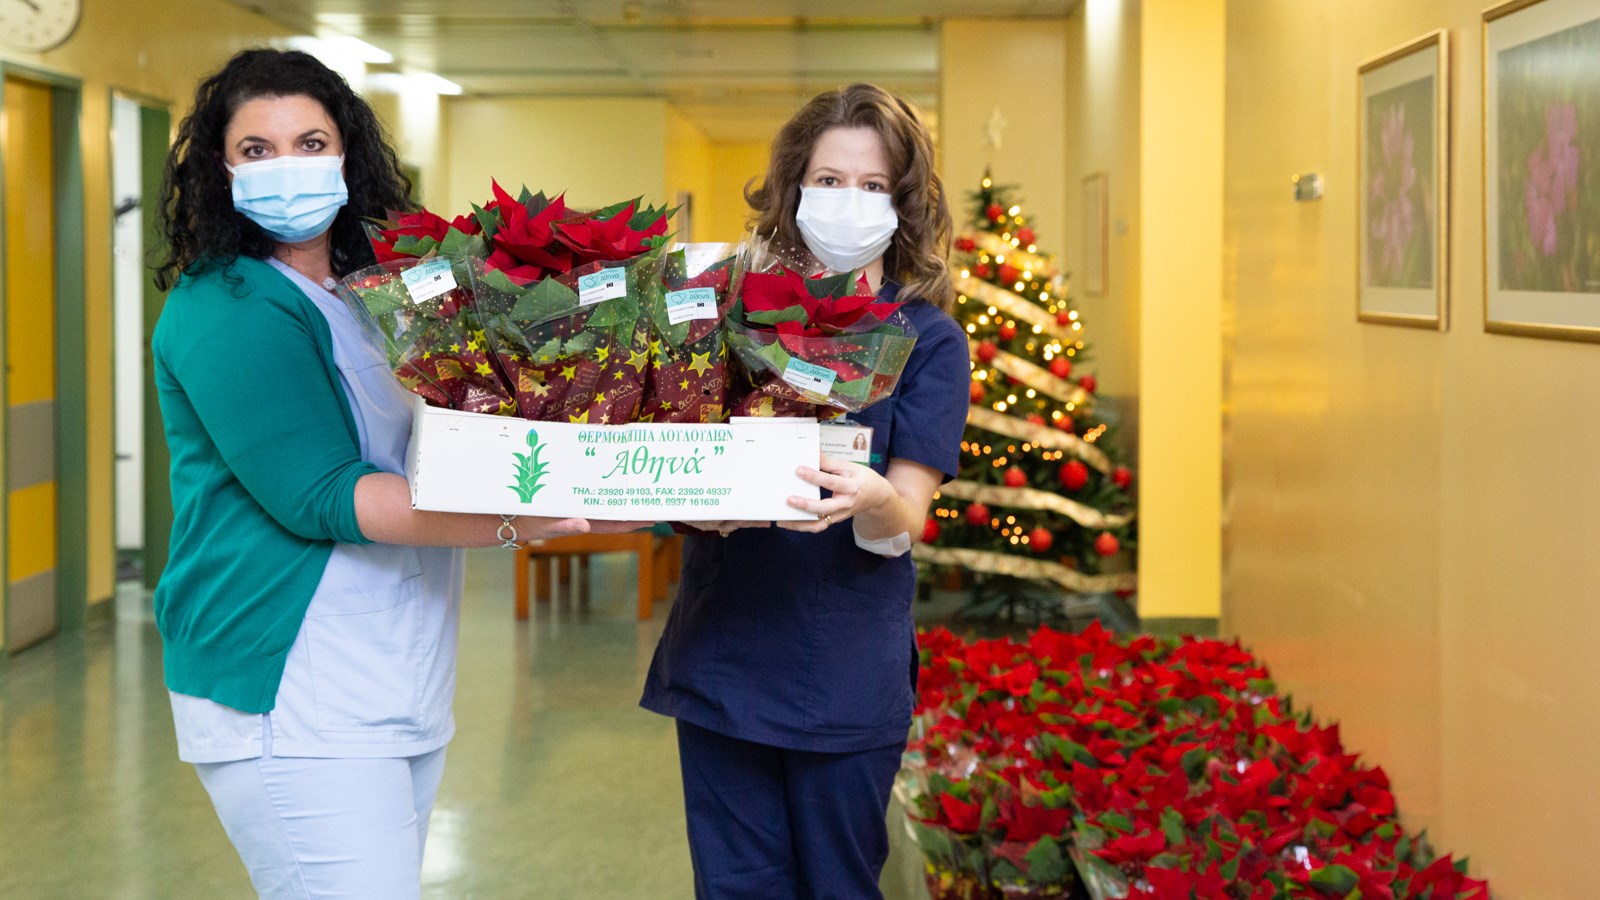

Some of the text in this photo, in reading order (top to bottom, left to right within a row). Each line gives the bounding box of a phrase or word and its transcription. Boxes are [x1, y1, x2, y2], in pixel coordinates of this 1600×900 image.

[658, 428, 734, 442] ΛΟΥΛΟΥΔΙΩΝ
[597, 487, 624, 496] 23920
[625, 487, 653, 496] 49103,
[655, 487, 676, 496] FAX:
[677, 487, 705, 496] 23920
[706, 487, 732, 496] 49337
[607, 498, 628, 506] 6937
[665, 497, 687, 506] 6937
[689, 498, 720, 506] 161638
